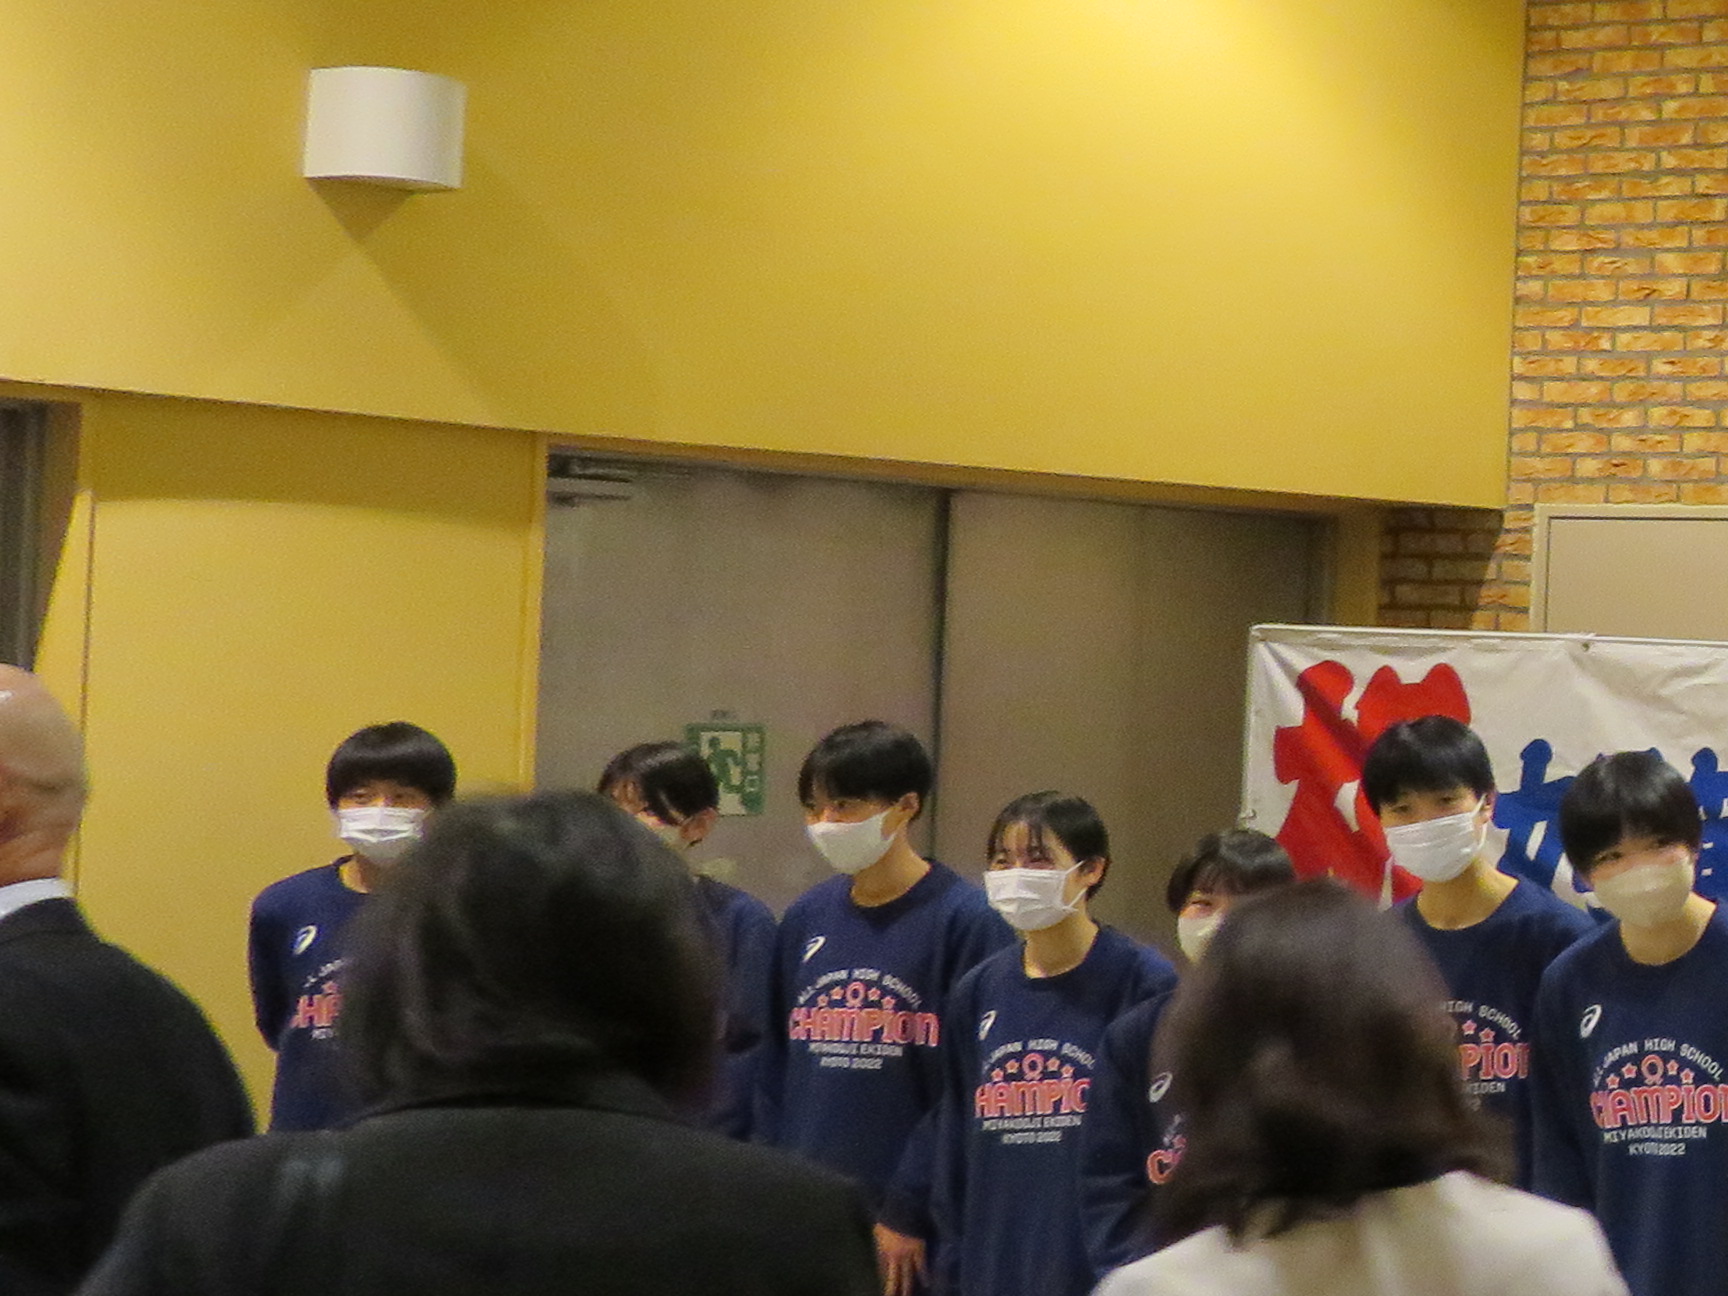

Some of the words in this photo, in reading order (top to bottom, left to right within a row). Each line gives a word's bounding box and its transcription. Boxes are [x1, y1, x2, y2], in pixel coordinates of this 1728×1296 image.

[1479, 1005, 1522, 1040] SCHOOL
[1644, 1038, 1676, 1052] HIGH
[1680, 1043, 1725, 1081] SCHOOL
[975, 1078, 1091, 1118] HAMPIO
[1465, 1082, 1506, 1094] IDEN
